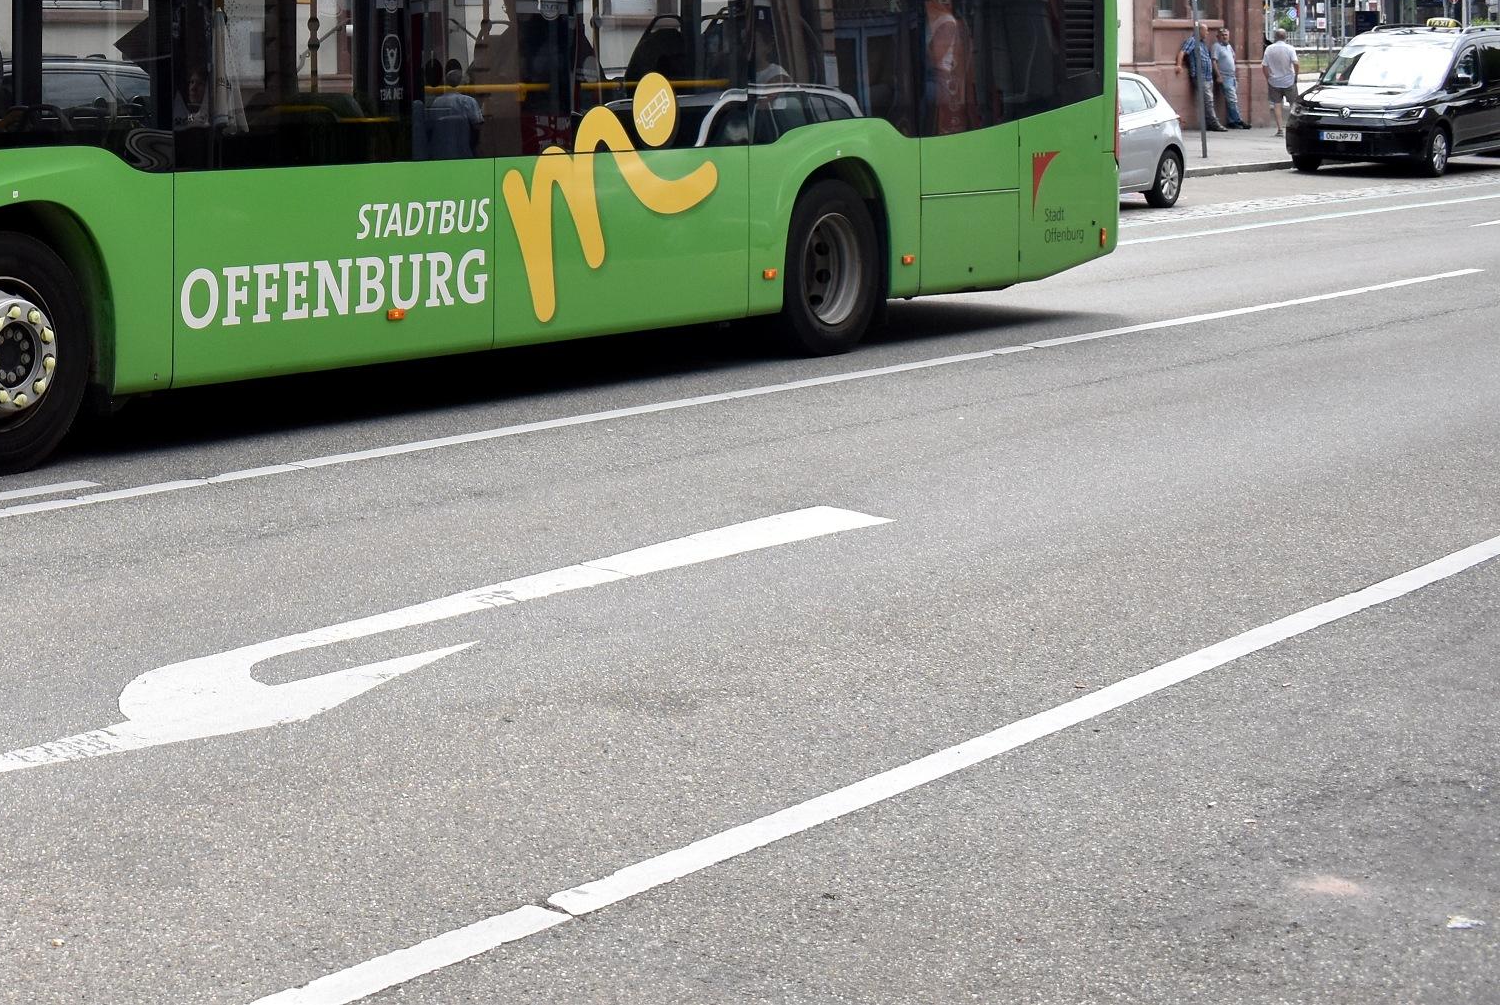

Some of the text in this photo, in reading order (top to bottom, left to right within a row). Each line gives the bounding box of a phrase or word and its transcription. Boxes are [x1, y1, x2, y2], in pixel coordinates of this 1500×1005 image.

[1429, 20, 1450, 28] TAXI
[357, 197, 490, 239] STADTBUS
[1044, 207, 1065, 222] Stadt
[1044, 228, 1084, 244] Offenburg
[180, 249, 488, 329] OFFENBURG
